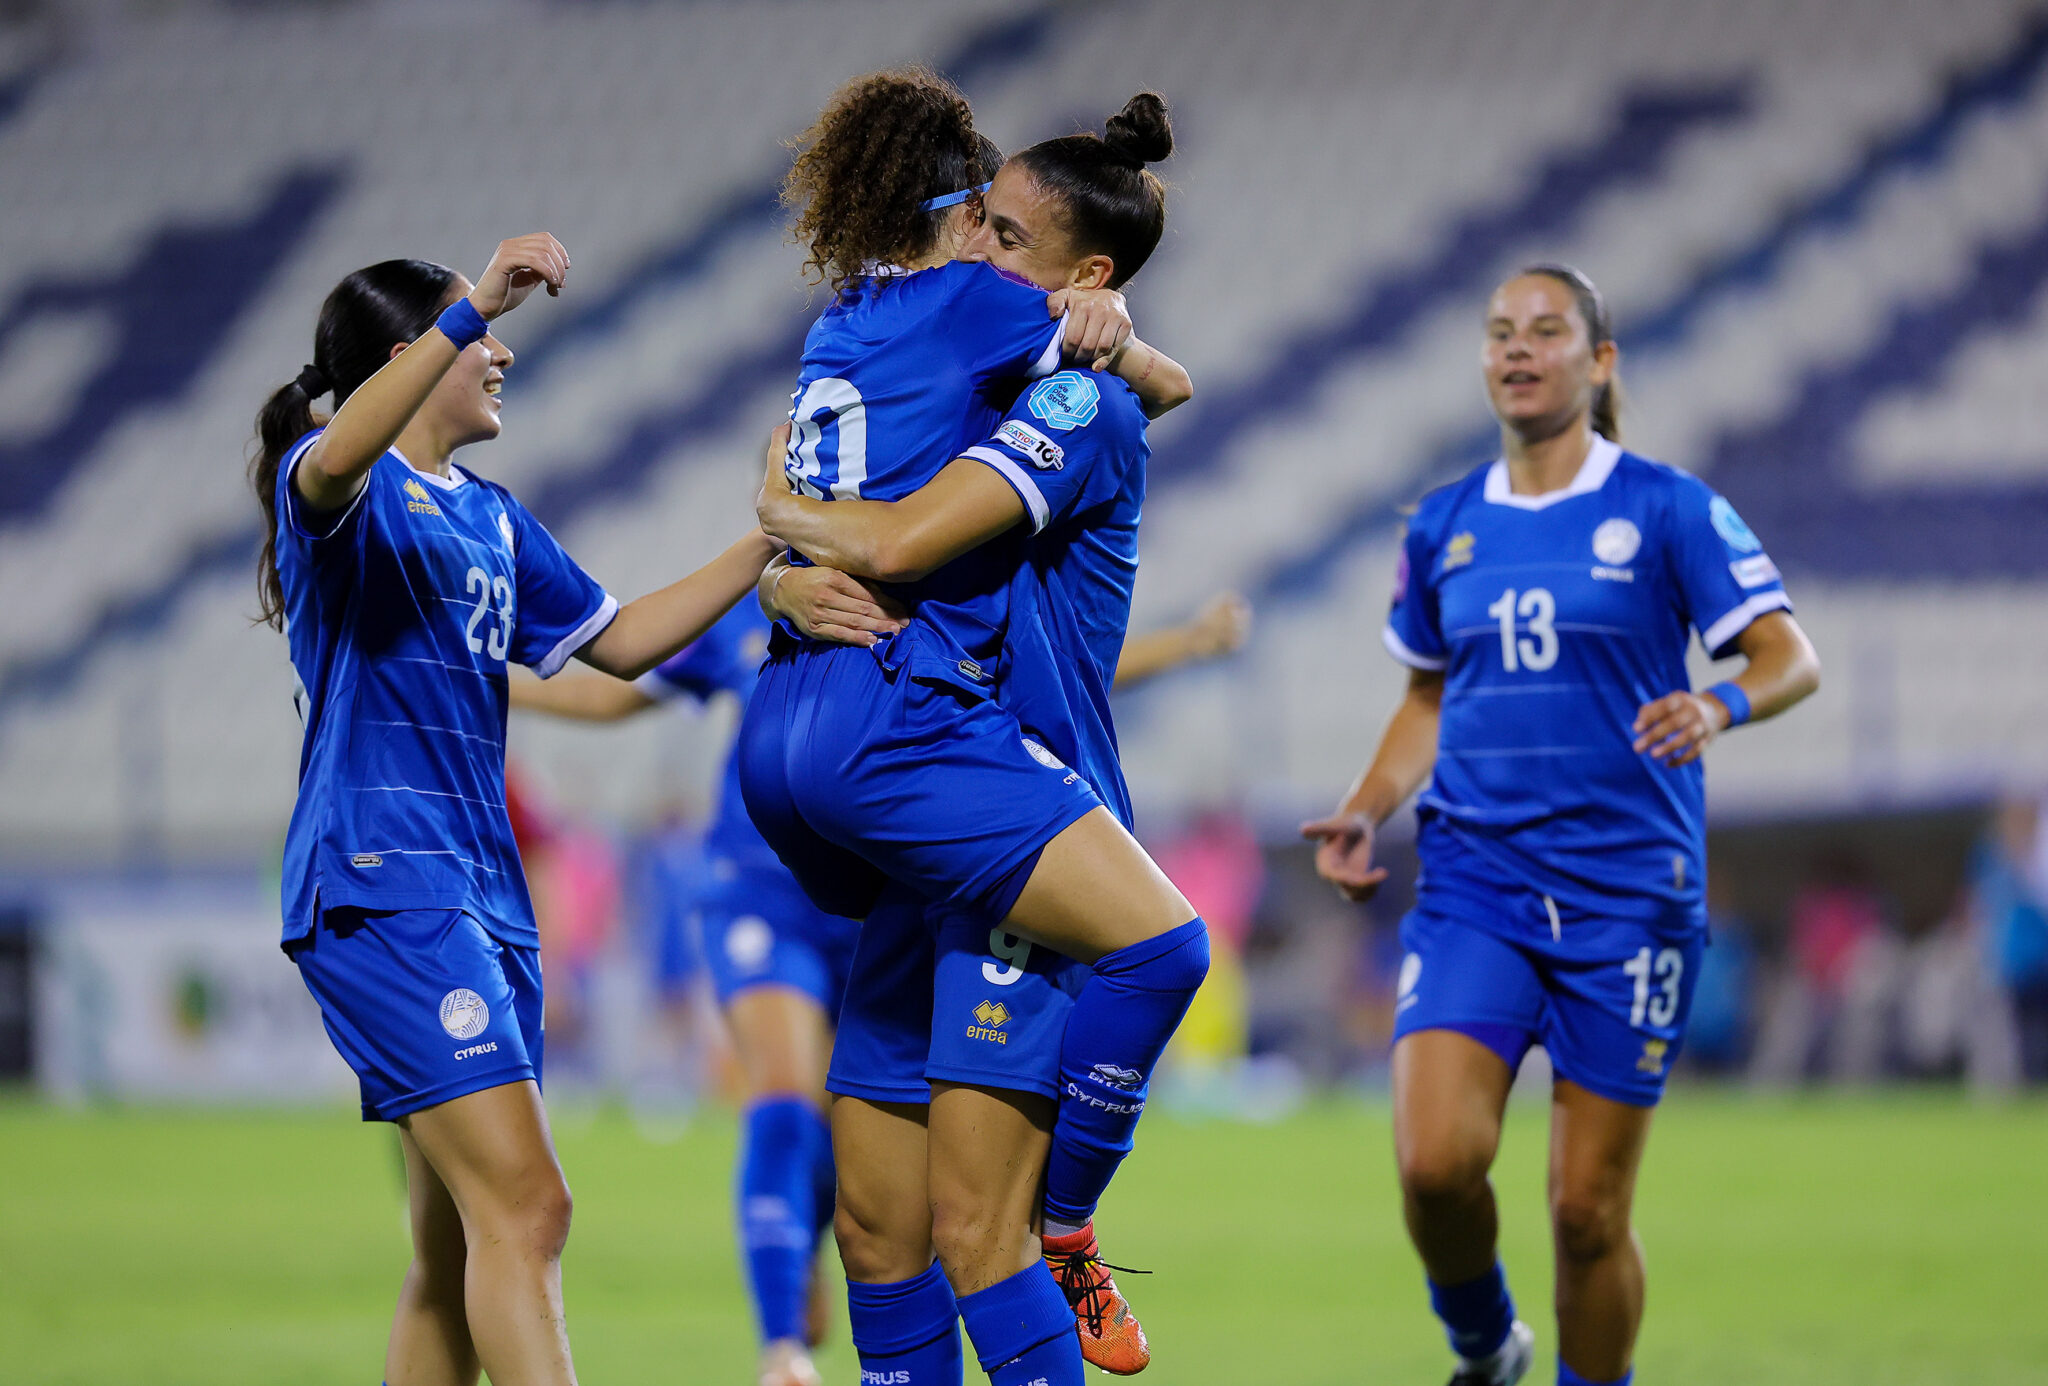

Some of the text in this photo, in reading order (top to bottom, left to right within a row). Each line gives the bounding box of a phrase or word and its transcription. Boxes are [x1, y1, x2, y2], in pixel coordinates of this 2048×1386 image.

[1035, 440, 1054, 462] 10
[407, 501, 440, 516] errea
[466, 566, 513, 660] 23
[1488, 587, 1559, 672] 13
[981, 927, 1032, 986] 9
[1623, 946, 1683, 1027] 13
[454, 1041, 498, 1061] CYPRUS
[966, 1025, 1008, 1045] errea
[1067, 1082, 1145, 1114] CYPRUS
